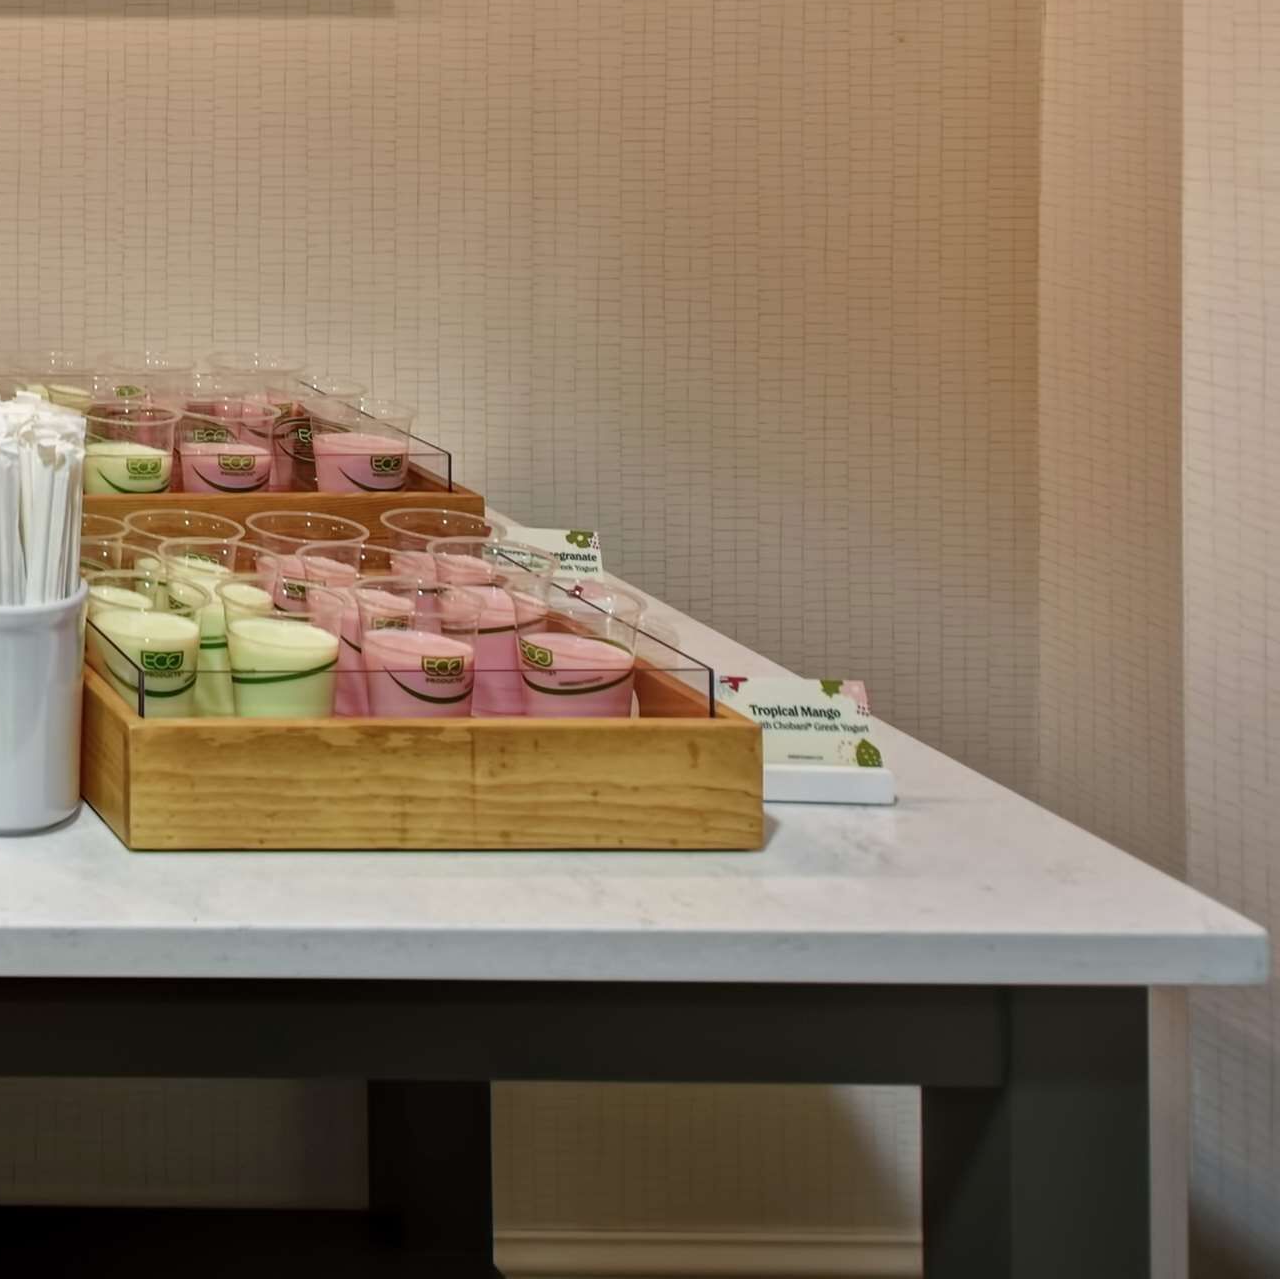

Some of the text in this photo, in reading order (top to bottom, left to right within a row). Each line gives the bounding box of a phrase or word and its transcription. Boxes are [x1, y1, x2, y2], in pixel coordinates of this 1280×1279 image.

[750, 704, 841, 720] Tropical Mango
[814, 722, 840, 731] Greek
[841, 723, 869, 734] Yogurt
